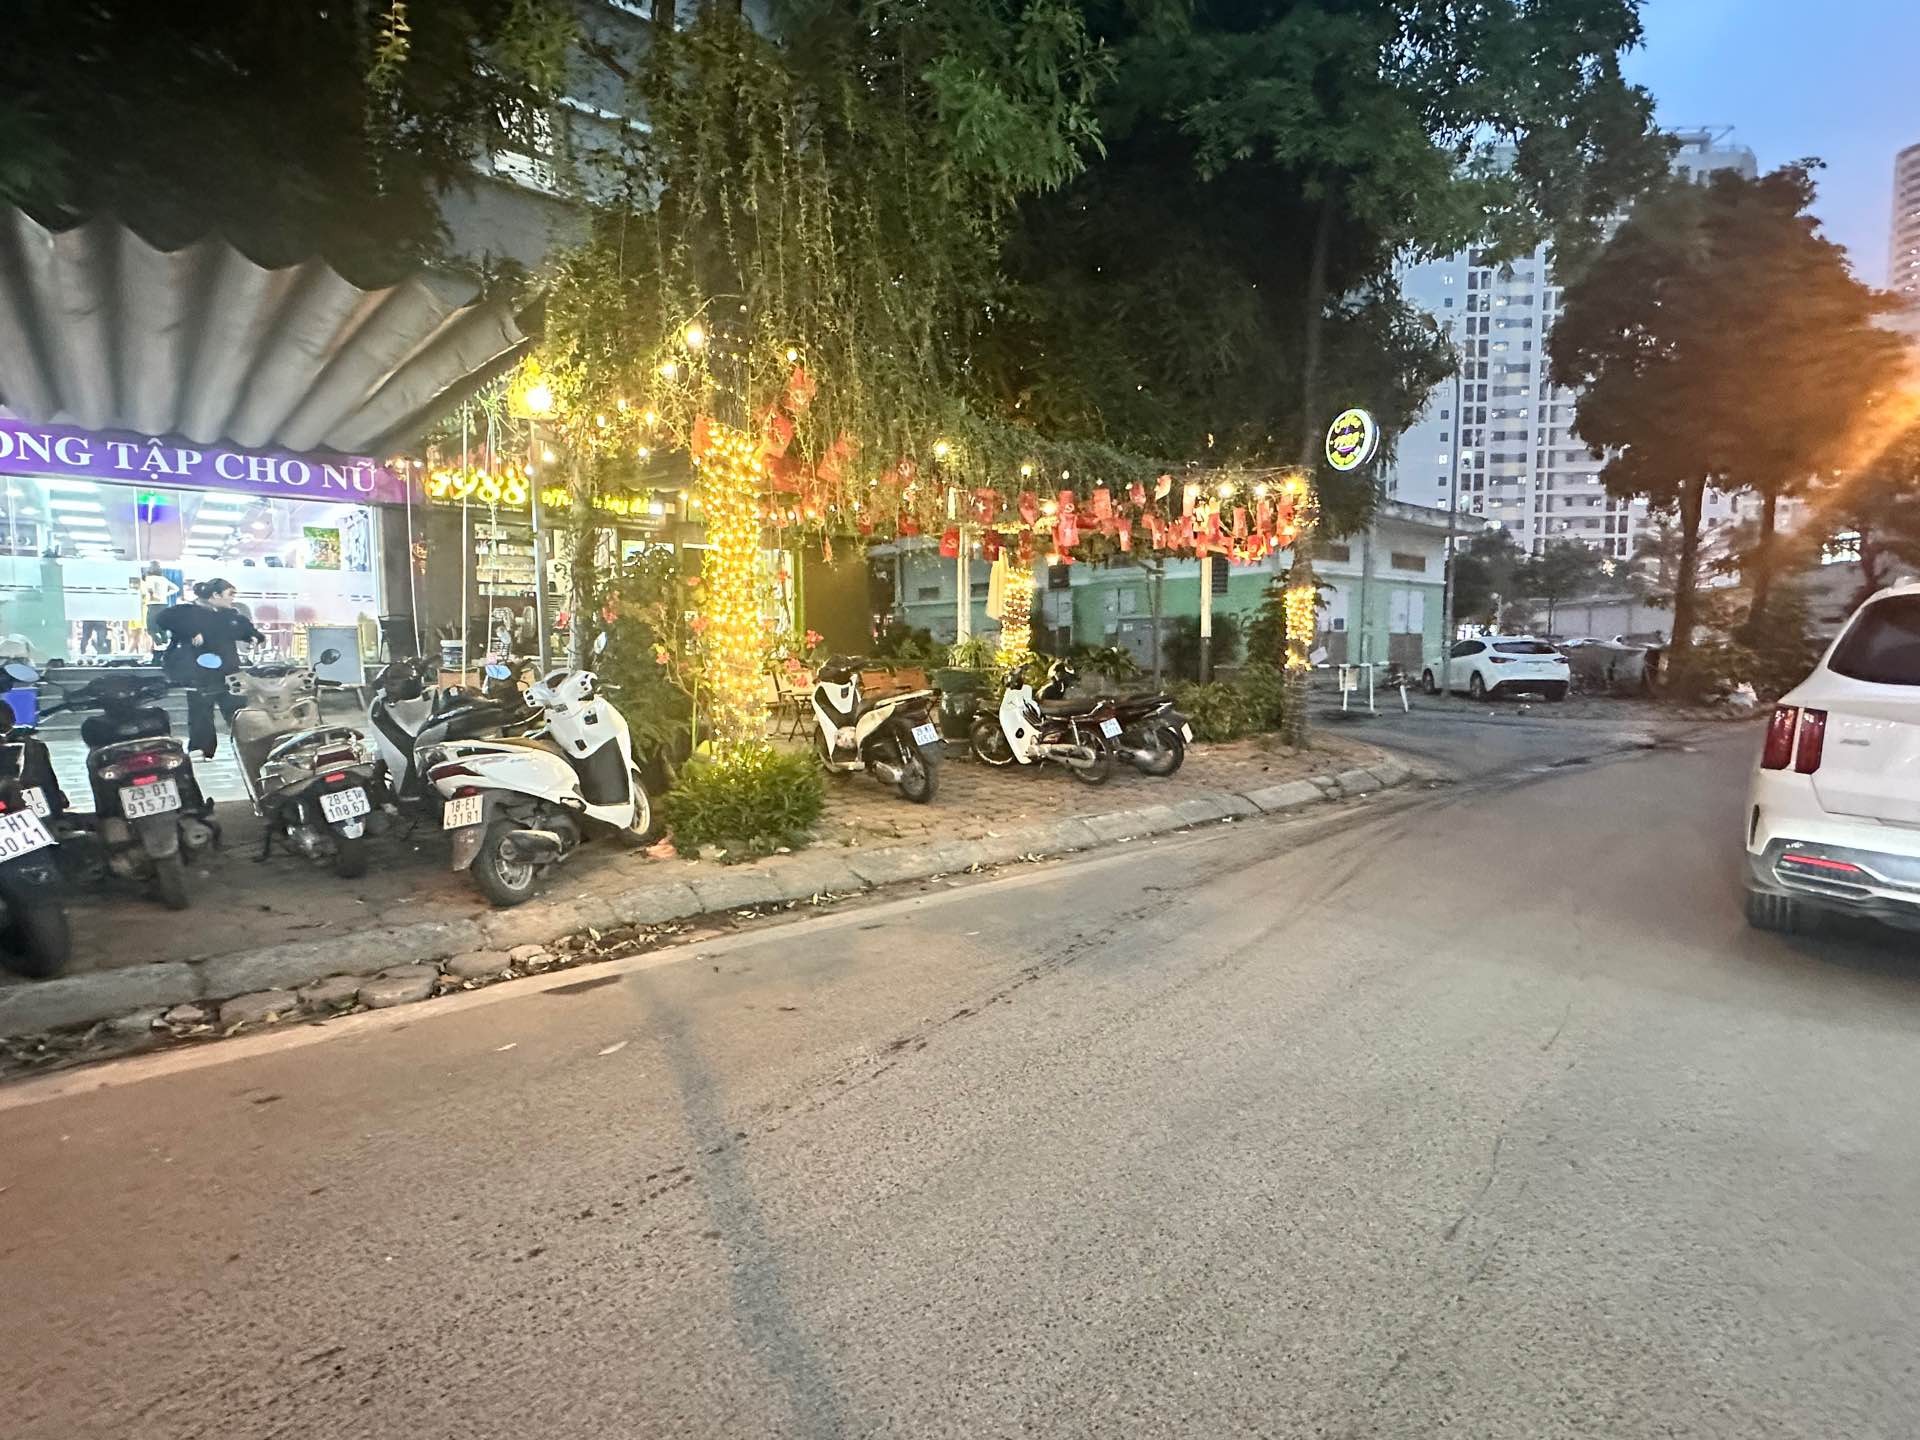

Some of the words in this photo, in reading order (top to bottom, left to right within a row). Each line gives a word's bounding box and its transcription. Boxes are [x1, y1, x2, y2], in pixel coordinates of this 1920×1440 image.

[107, 437, 202, 480] TẬP
[215, 452, 311, 486] CHO
[321, 459, 377, 492] NỮ
